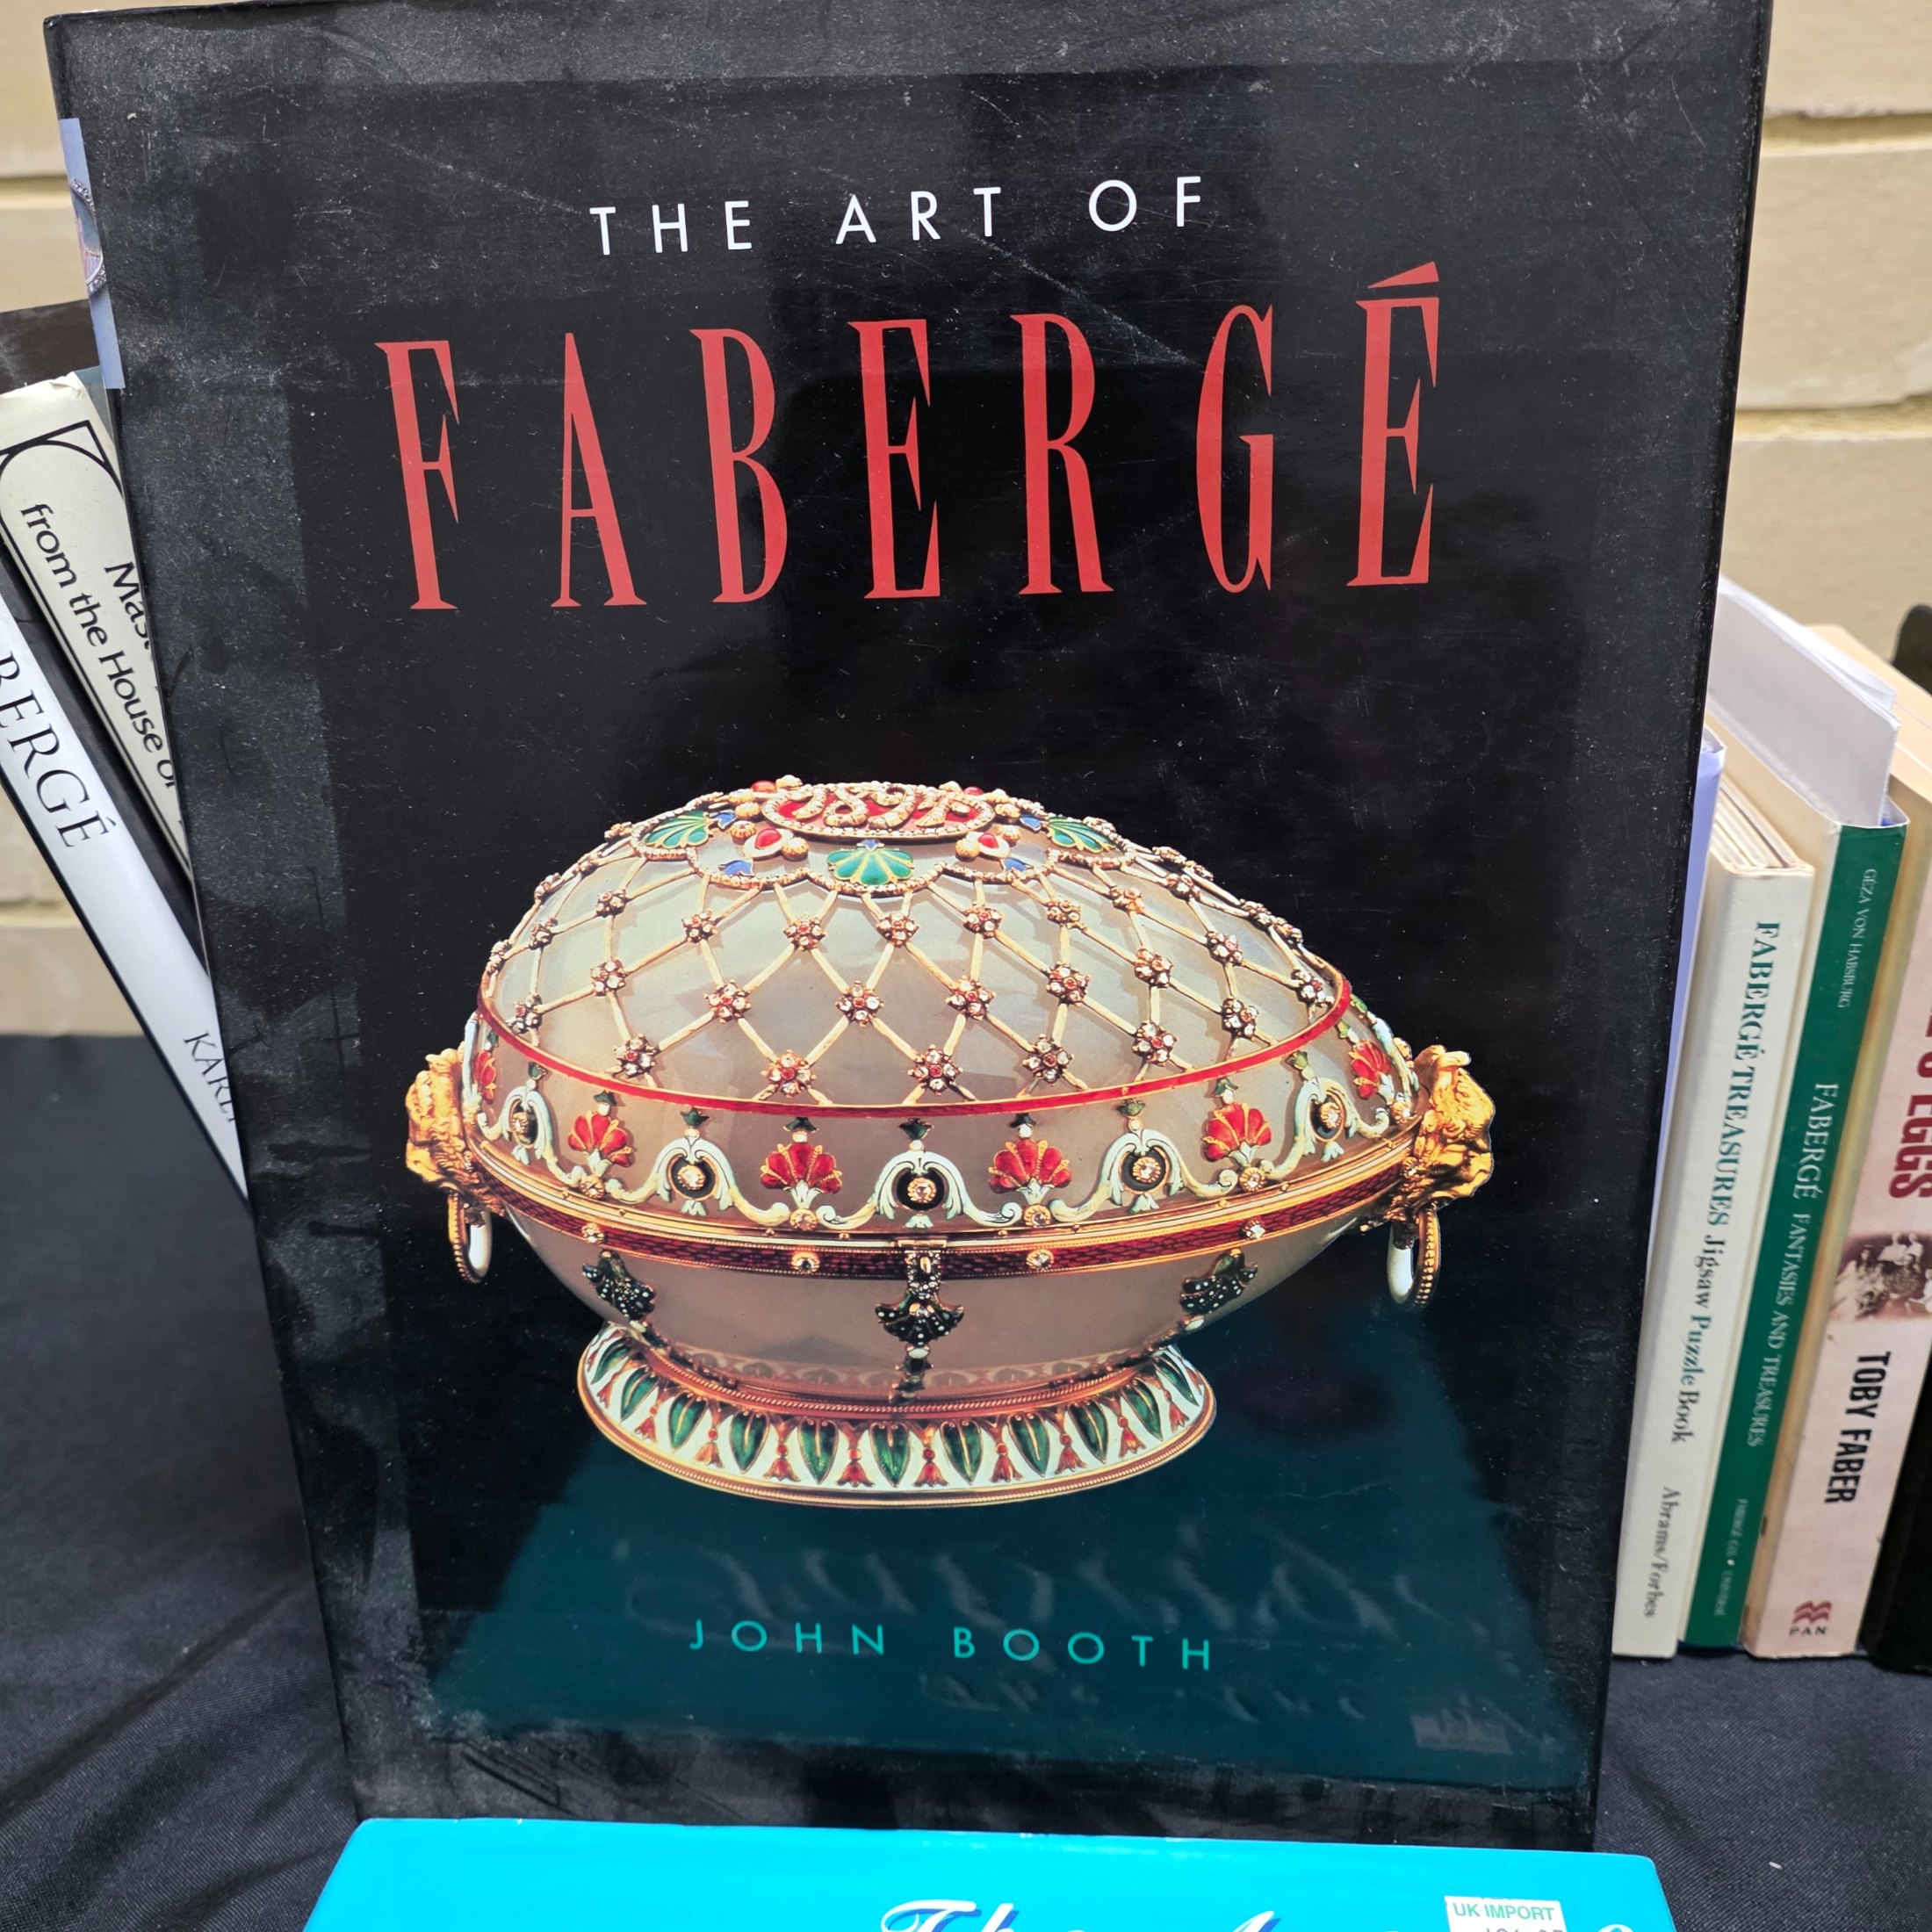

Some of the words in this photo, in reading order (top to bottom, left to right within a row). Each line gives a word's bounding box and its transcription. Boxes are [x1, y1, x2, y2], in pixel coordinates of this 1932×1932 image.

[590, 201, 753, 256] THE
[835, 186, 1002, 247] ART
[1088, 176, 1202, 233] OF
[373, 261, 1440, 610] FABERGÉ
[20, 502, 77, 589] from
[68, 593, 108, 648] the
[98, 650, 164, 753] House
[156, 758, 176, 789] o
[1851, 908, 1871, 940] VON
[1734, 921, 1780, 1061] FABERGÉ
[1838, 943, 1862, 1009] HABSBURG
[1707, 1065, 1755, 1227] TREASURES
[1793, 1083, 1840, 1200] FABERGÉ
[1694, 1234, 1726, 1309] Jigsaw
[1775, 1213, 1811, 1307] FANTASIES
[1680, 1314, 1712, 1387] Puzzle
[1767, 1311, 1790, 1350] AND
[1670, 1390, 1700, 1445] Book
[1746, 1354, 1783, 1449] TREASURES
[1845, 1351, 1892, 1420] TOBY
[1824, 1428, 1873, 1505] FABER
[690, 1618, 887, 1657] JOHN
[955, 1626, 1213, 1672] BOOTH
[1789, 1626, 1827, 1636] PAN
[1453, 1901, 1481, 1917] UK
[1483, 1904, 1555, 1921] IMPORT
